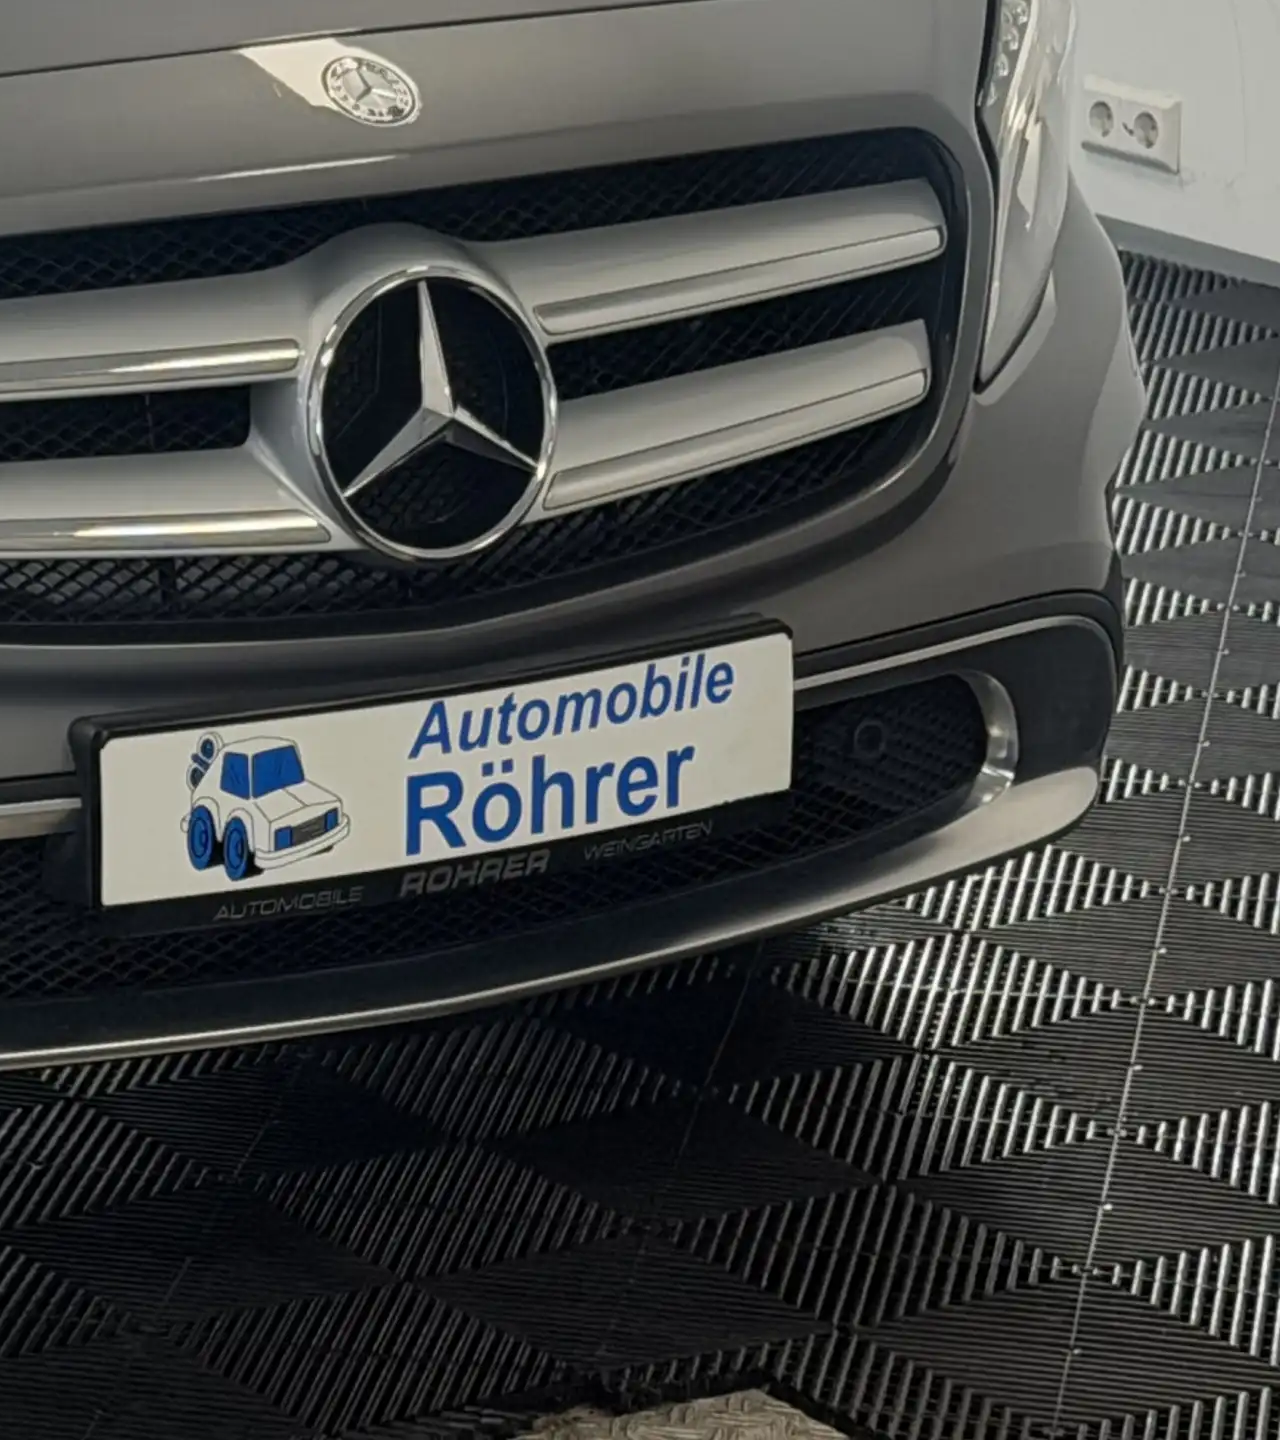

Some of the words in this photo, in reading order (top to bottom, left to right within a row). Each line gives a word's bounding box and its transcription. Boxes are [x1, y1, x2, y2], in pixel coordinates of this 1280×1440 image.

[409, 653, 734, 759] Automobile
[405, 745, 695, 856] Röhrer
[212, 886, 365, 921] AUTOMOBILE
[583, 819, 713, 861] WEINGARTEN
